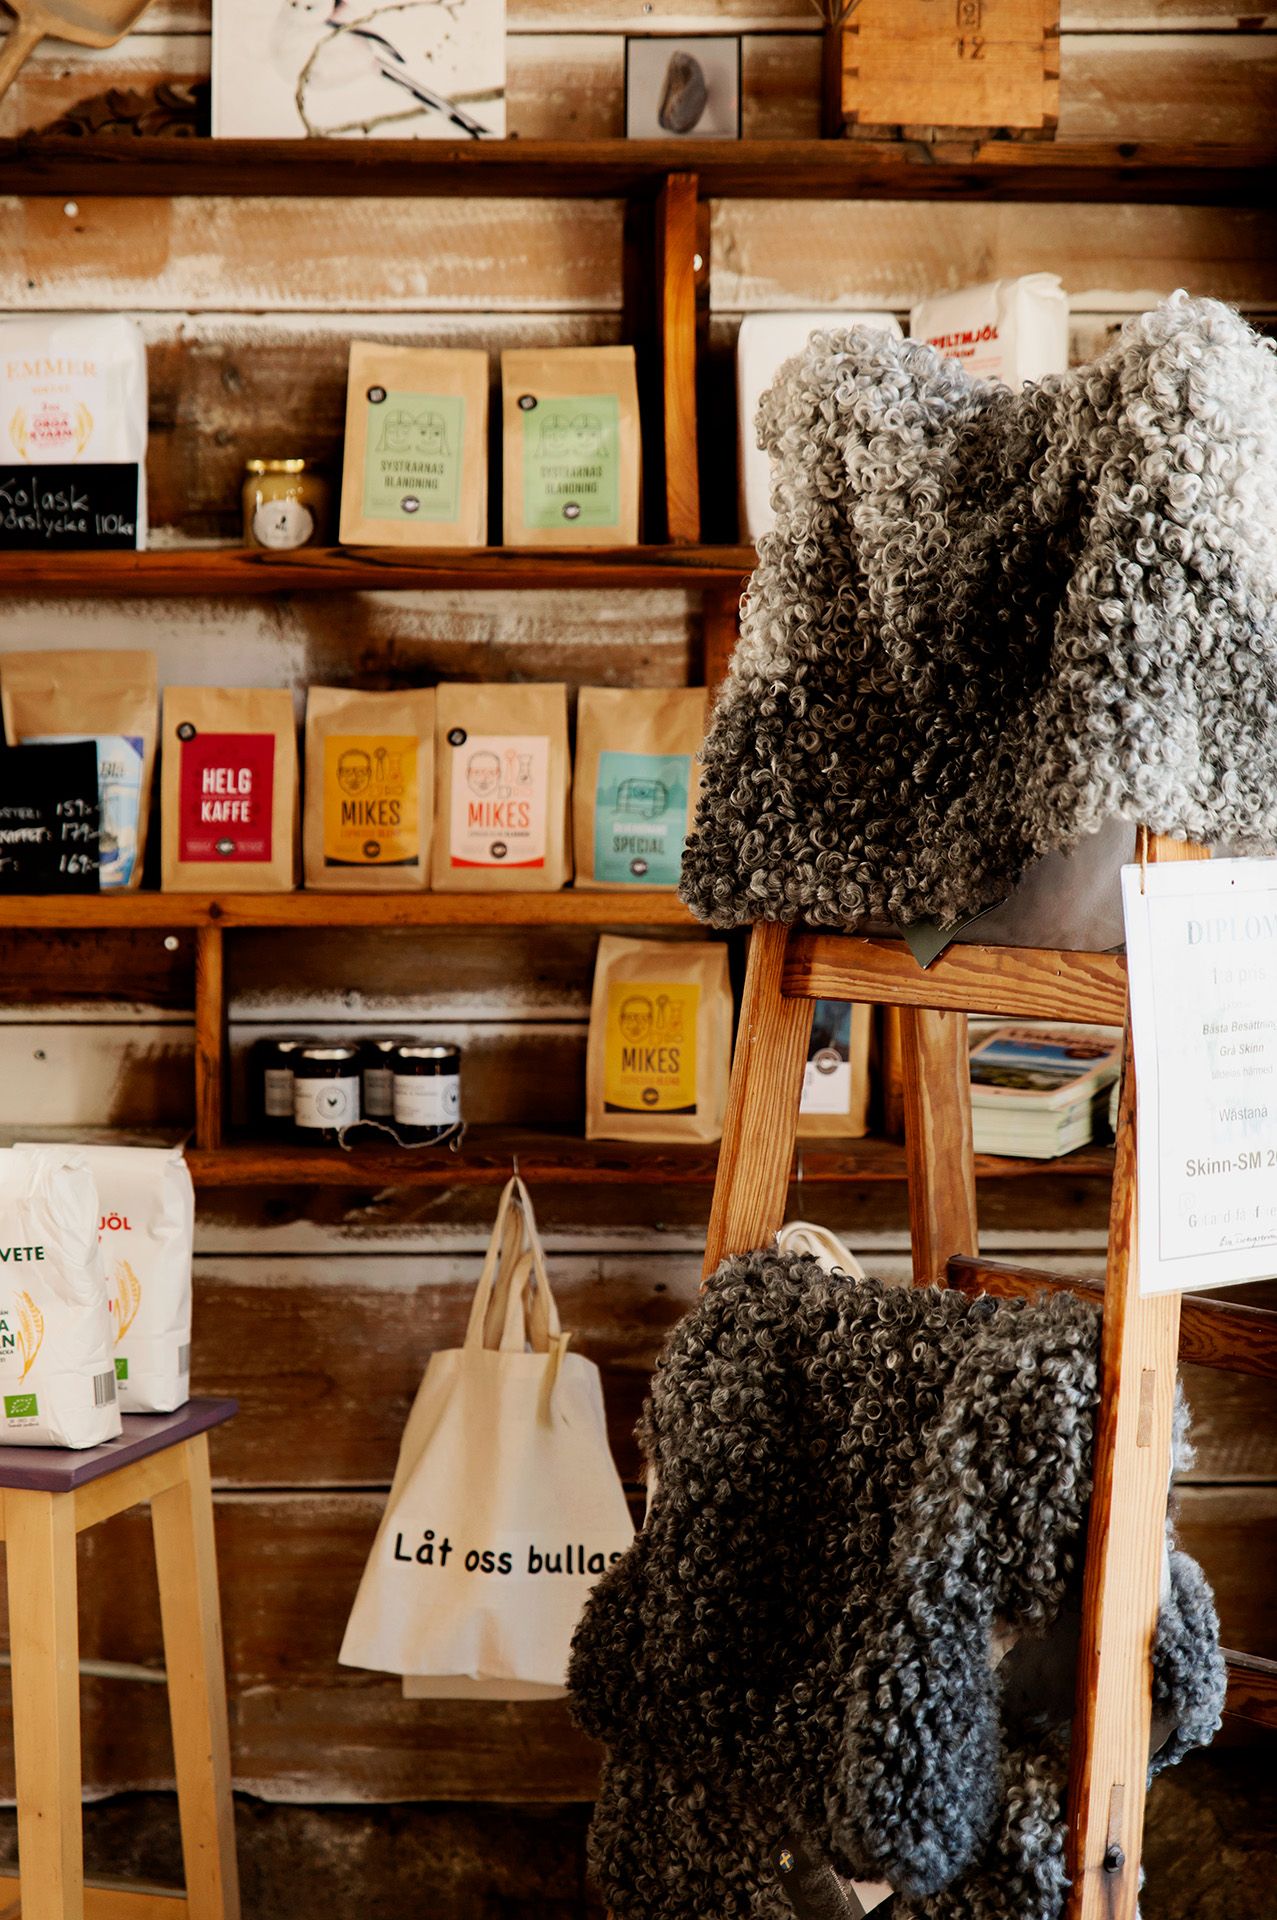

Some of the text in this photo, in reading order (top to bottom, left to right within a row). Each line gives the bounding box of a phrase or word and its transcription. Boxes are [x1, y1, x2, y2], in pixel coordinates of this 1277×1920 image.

[927, 324, 999, 349] PELTMJÖL
[202, 767, 252, 795] HELG
[200, 800, 251, 823] KAFFE
[340, 799, 401, 827] MIKES
[467, 801, 531, 829] MIKES
[612, 834, 666, 855] SPECIAL
[621, 1046, 681, 1074] MIKES
[1239, 1041, 1265, 1055] Skinn
[1185, 1148, 1277, 1178] Skinn-SM 2
[0, 1246, 45, 1262] VETE
[394, 1529, 453, 1568] Låt
[464, 1549, 513, 1575] oss
